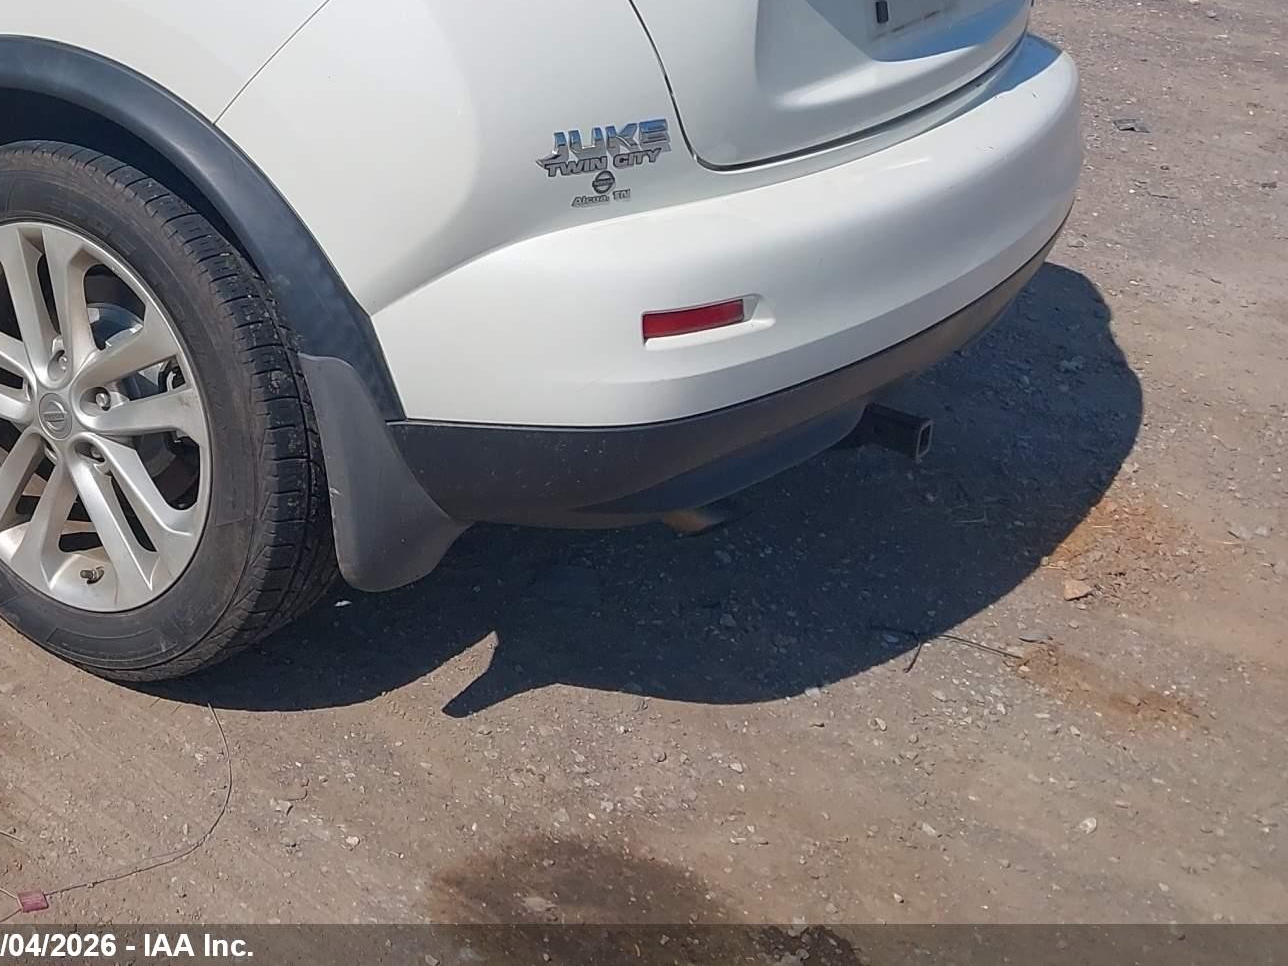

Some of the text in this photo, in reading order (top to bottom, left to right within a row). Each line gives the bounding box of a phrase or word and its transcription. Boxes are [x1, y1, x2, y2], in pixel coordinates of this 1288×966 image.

[536, 118, 672, 169] JUKE
[544, 147, 662, 178] TWIN CITY
[613, 189, 632, 202] TN
